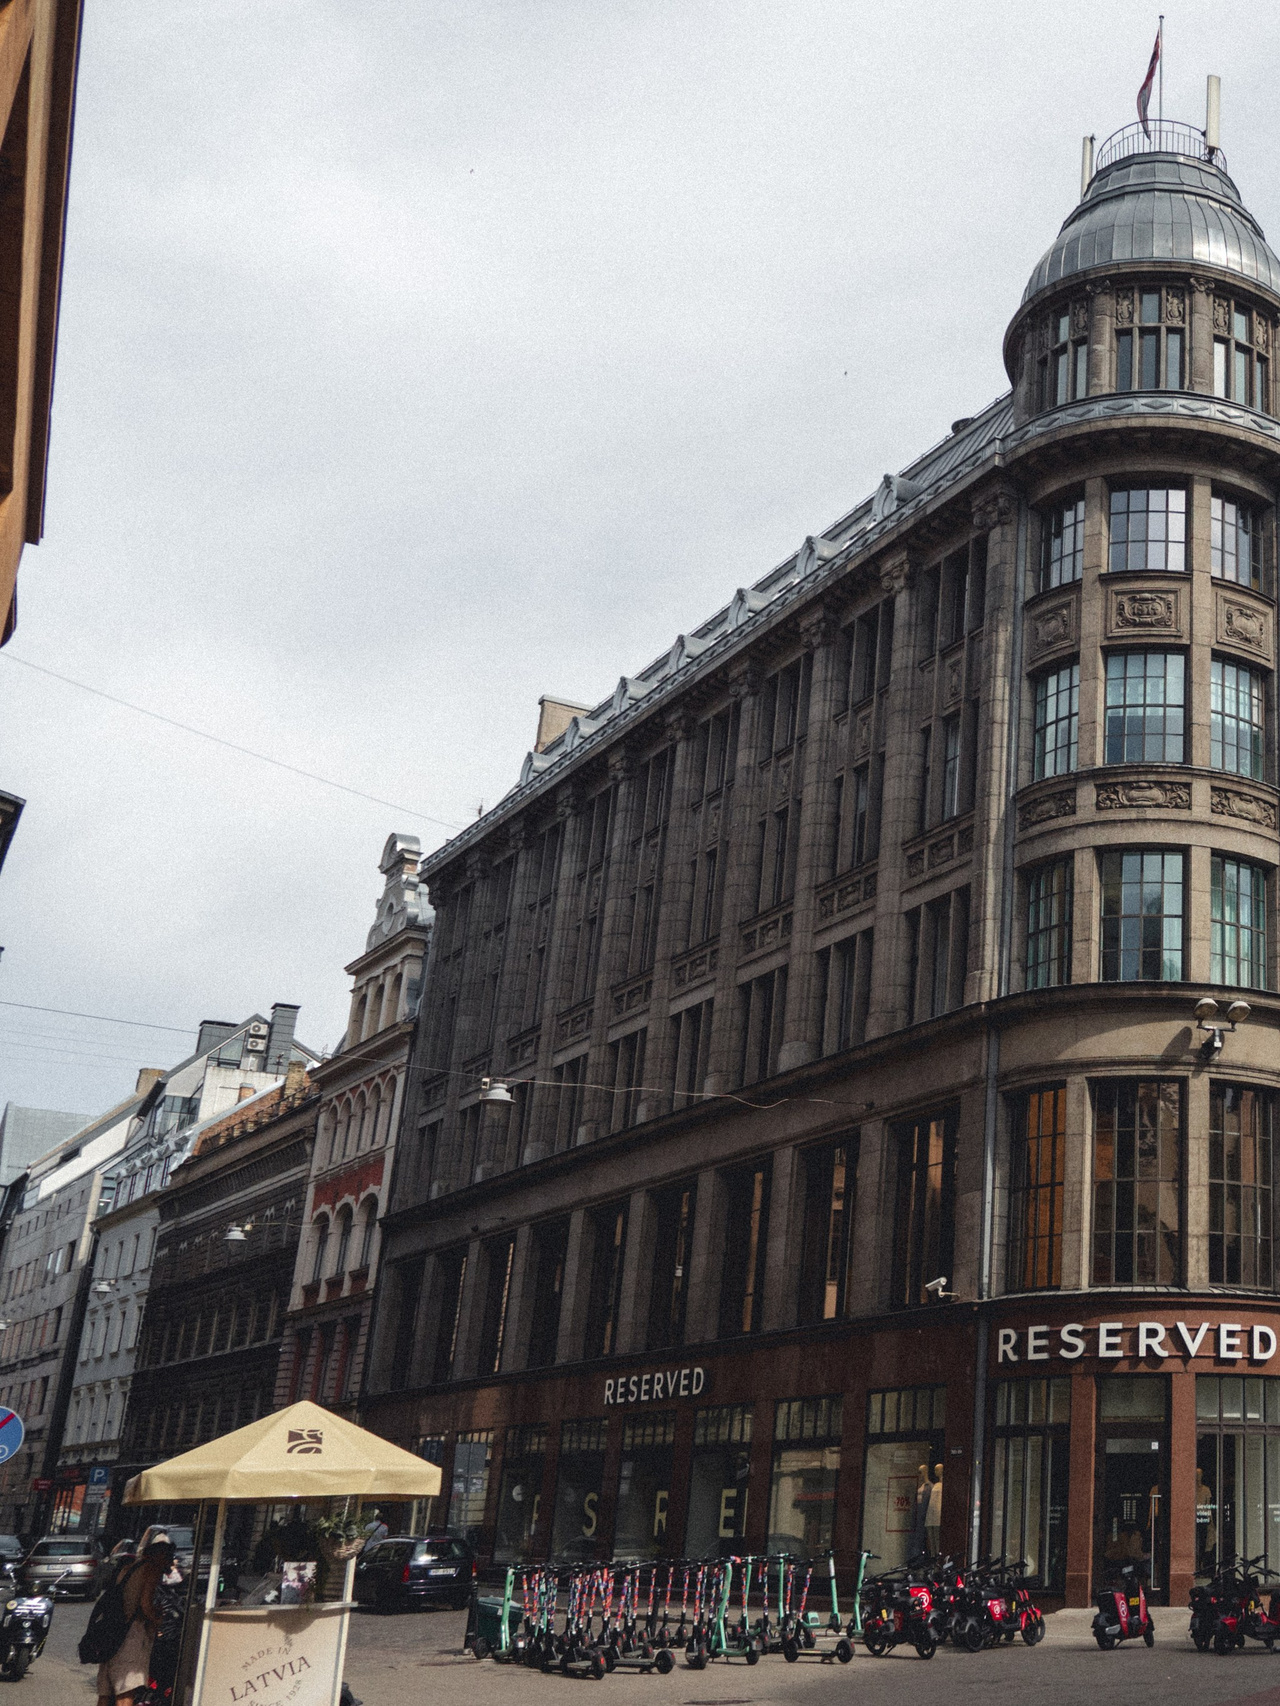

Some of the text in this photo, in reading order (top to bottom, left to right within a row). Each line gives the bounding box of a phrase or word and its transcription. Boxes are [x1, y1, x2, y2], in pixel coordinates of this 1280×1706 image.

[998, 1321, 1277, 1363] RESERVED
[604, 1367, 704, 1405] RESERVED
[229, 1656, 311, 1702] LATVIA
[241, 1646, 291, 1672] MADE IN
